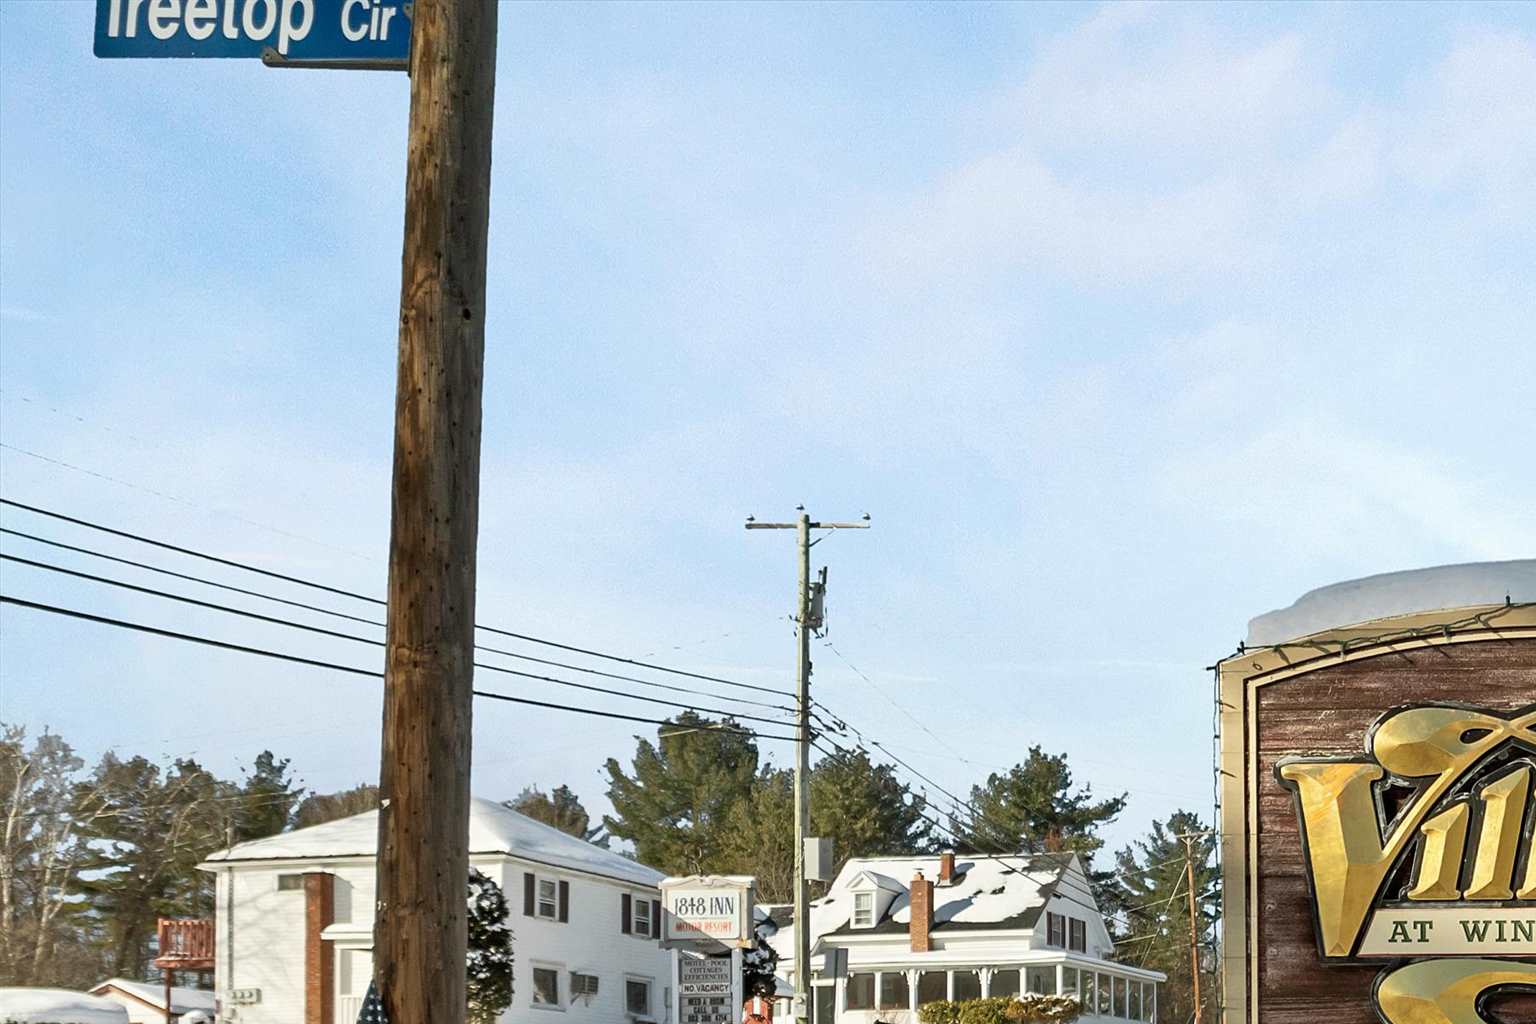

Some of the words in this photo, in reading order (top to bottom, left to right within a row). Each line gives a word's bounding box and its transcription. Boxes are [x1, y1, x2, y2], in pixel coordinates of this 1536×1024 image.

[341, 0, 397, 41] Cir
[674, 897, 706, 916] 1848
[710, 897, 735, 916] INN
[1388, 920, 1434, 944] AT
[696, 984, 729, 993] VACANCY
